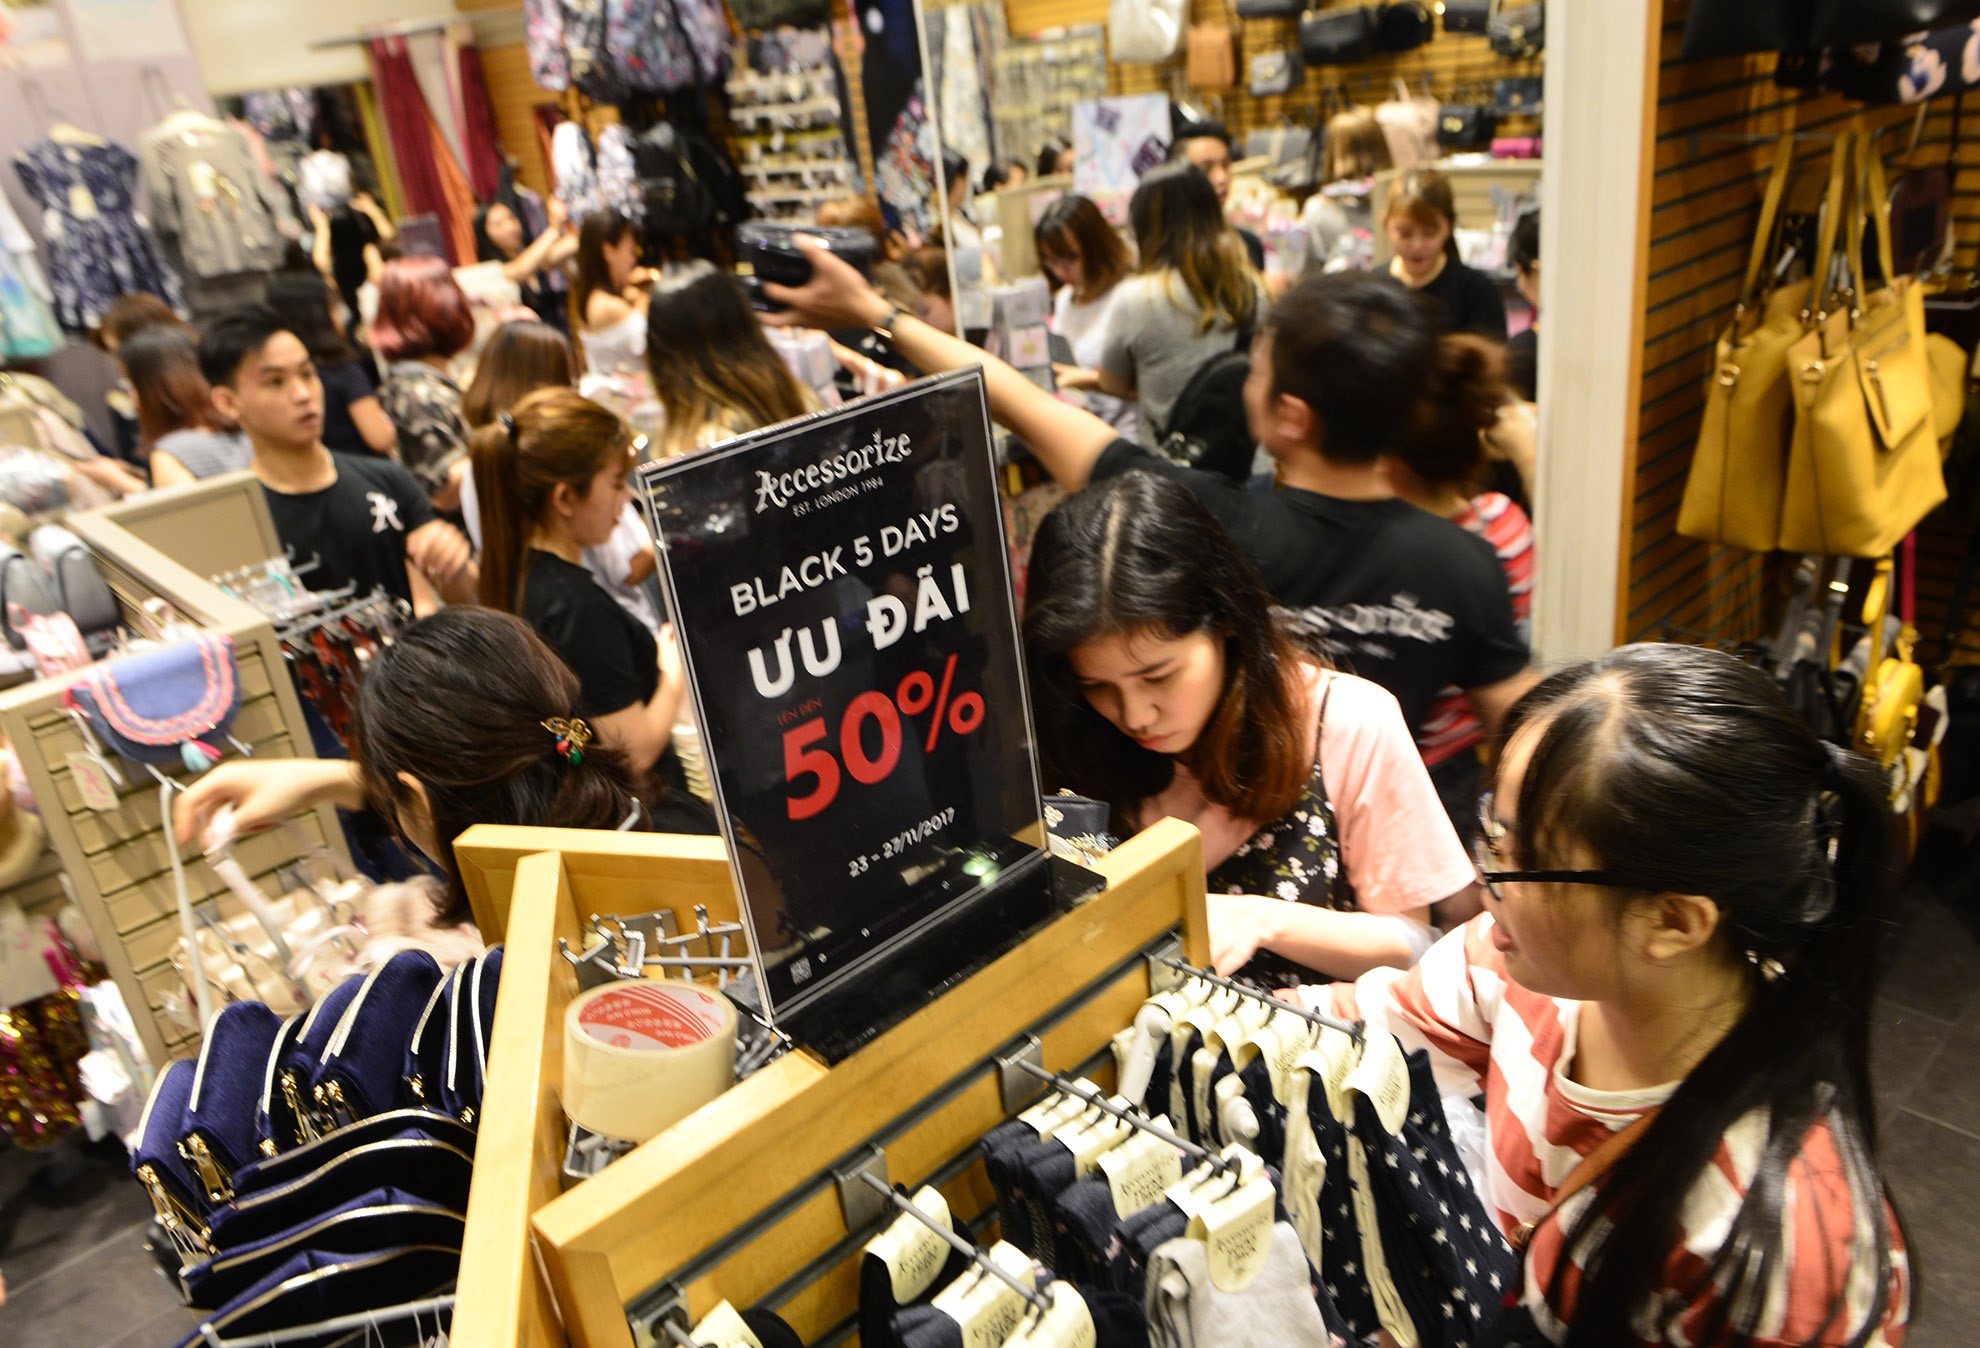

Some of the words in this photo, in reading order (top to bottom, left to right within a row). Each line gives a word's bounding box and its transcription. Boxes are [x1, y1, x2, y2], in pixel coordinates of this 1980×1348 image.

[754, 428, 912, 514] Accessorize
[814, 484, 860, 510] LONDON
[730, 545, 848, 617] BLACK
[854, 535, 873, 567] 5
[881, 503, 959, 558] DAYS
[747, 616, 842, 699] ƯU
[865, 562, 971, 651] ĐÃI
[782, 653, 985, 820] 50%
[882, 807, 955, 859] 27/11/2017
